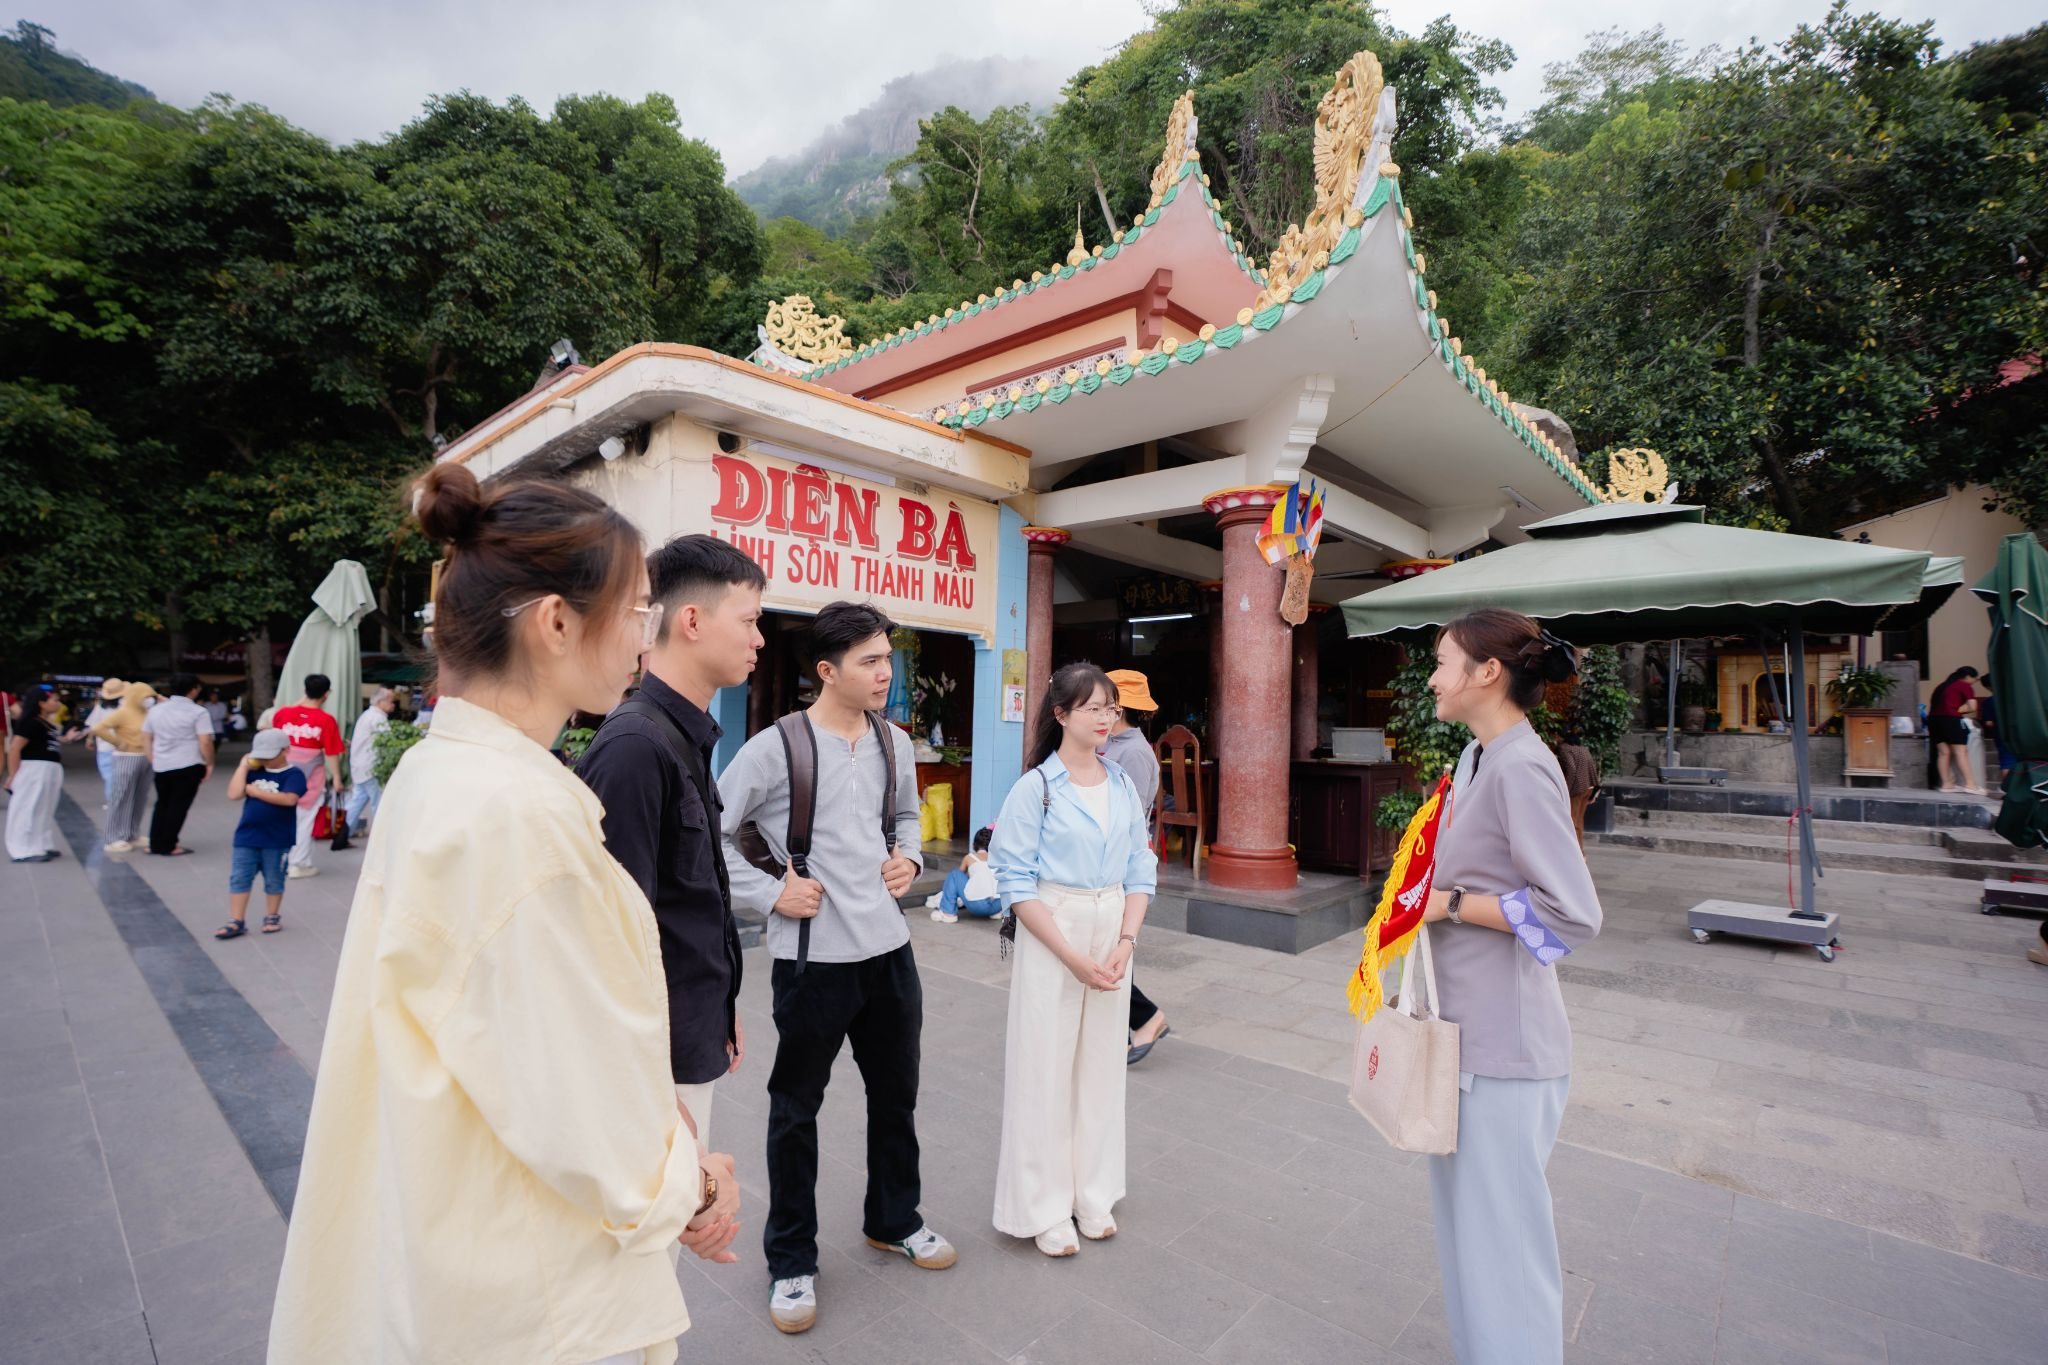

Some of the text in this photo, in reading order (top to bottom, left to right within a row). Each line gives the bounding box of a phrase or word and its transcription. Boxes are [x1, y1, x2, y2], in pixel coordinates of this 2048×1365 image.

[711, 525, 774, 580] INH
[851, 553, 923, 601] THÁNH
[897, 497, 976, 571] BÀ
